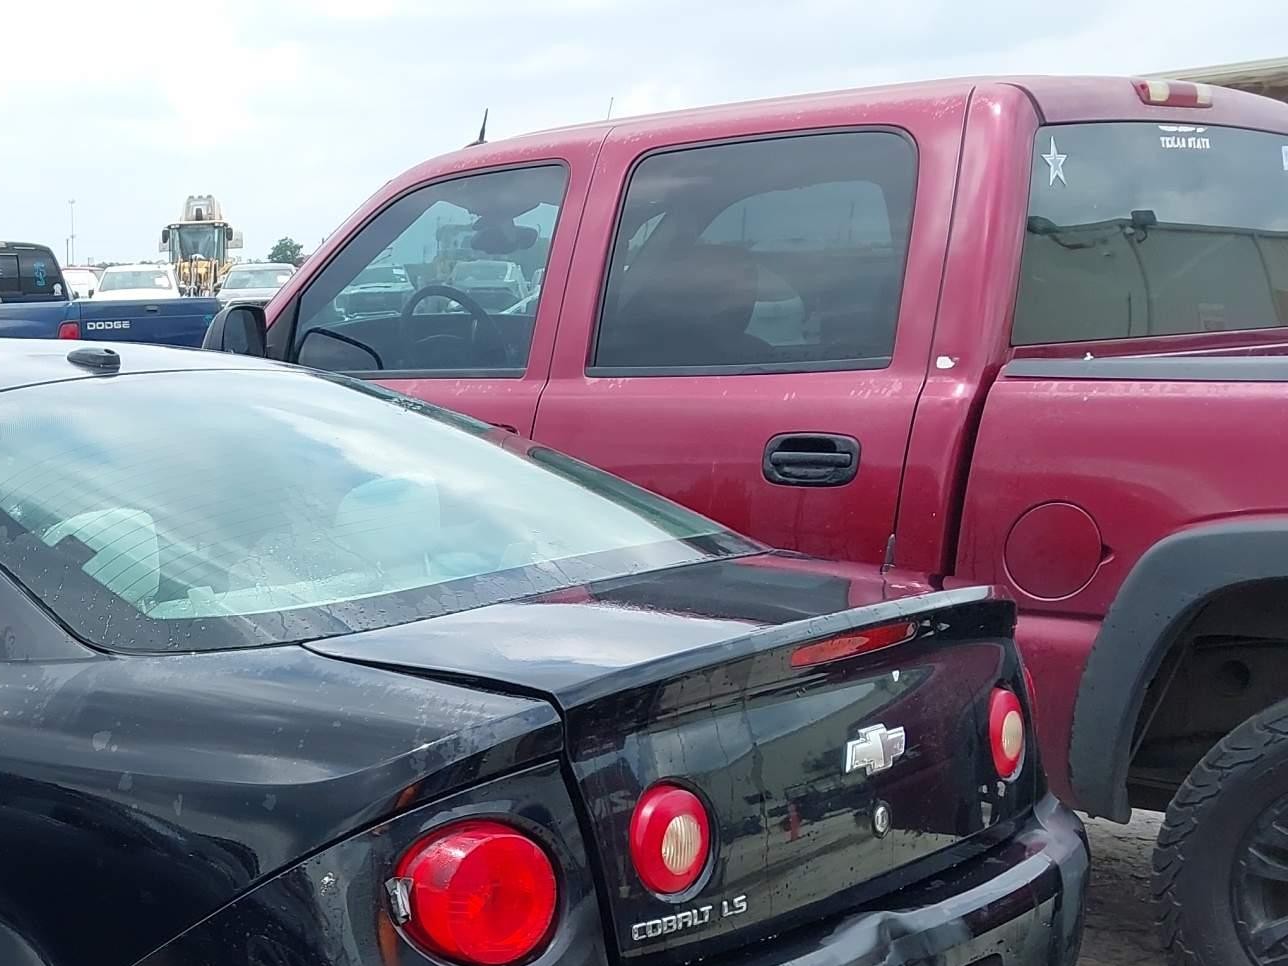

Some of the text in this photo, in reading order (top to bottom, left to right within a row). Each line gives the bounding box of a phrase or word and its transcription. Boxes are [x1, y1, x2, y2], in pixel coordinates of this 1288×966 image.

[87, 321, 130, 330] DODGE
[631, 894, 748, 941] COBALT LS
